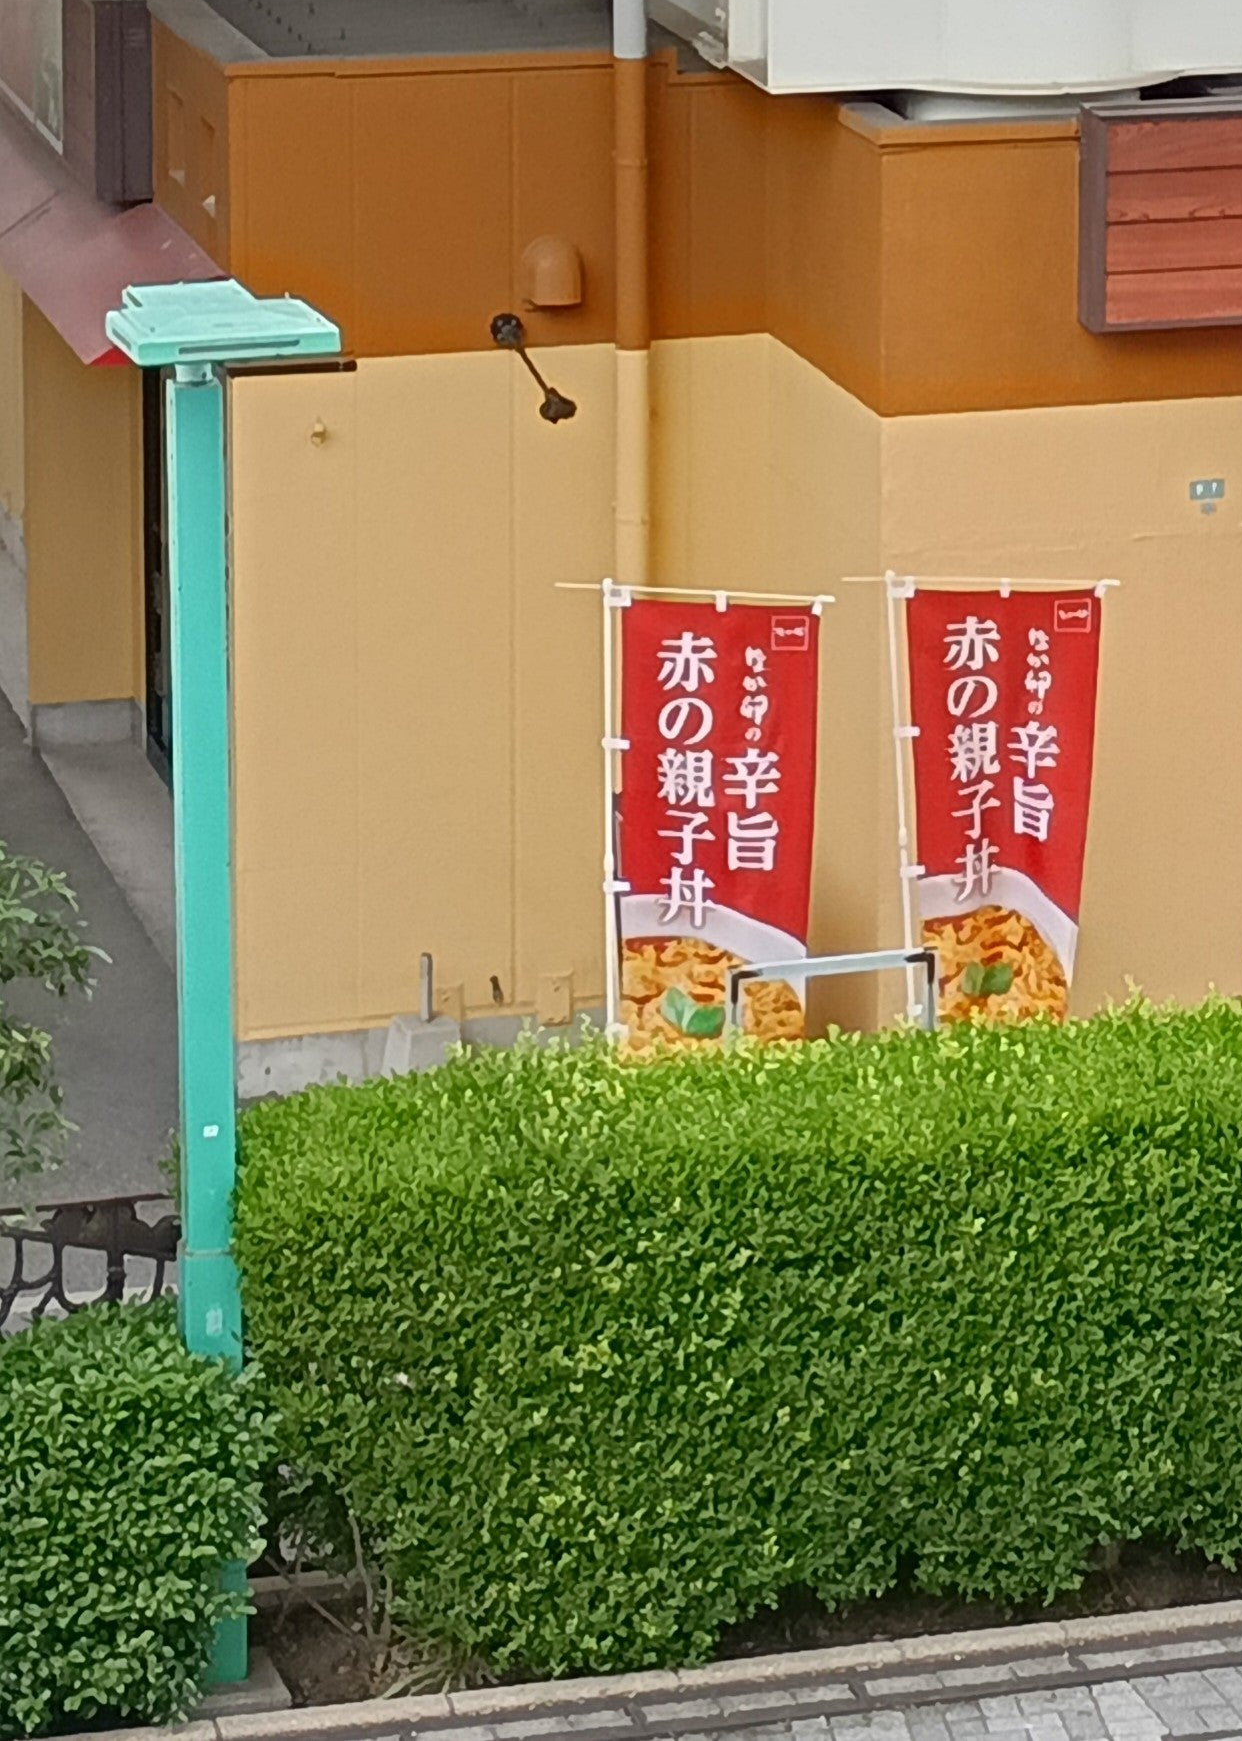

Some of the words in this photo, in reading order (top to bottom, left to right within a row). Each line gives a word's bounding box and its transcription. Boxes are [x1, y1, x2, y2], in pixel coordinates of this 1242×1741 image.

[656, 631, 718, 927] 赤の親子丼
[943, 616, 1001, 902] 赤の親子丼
